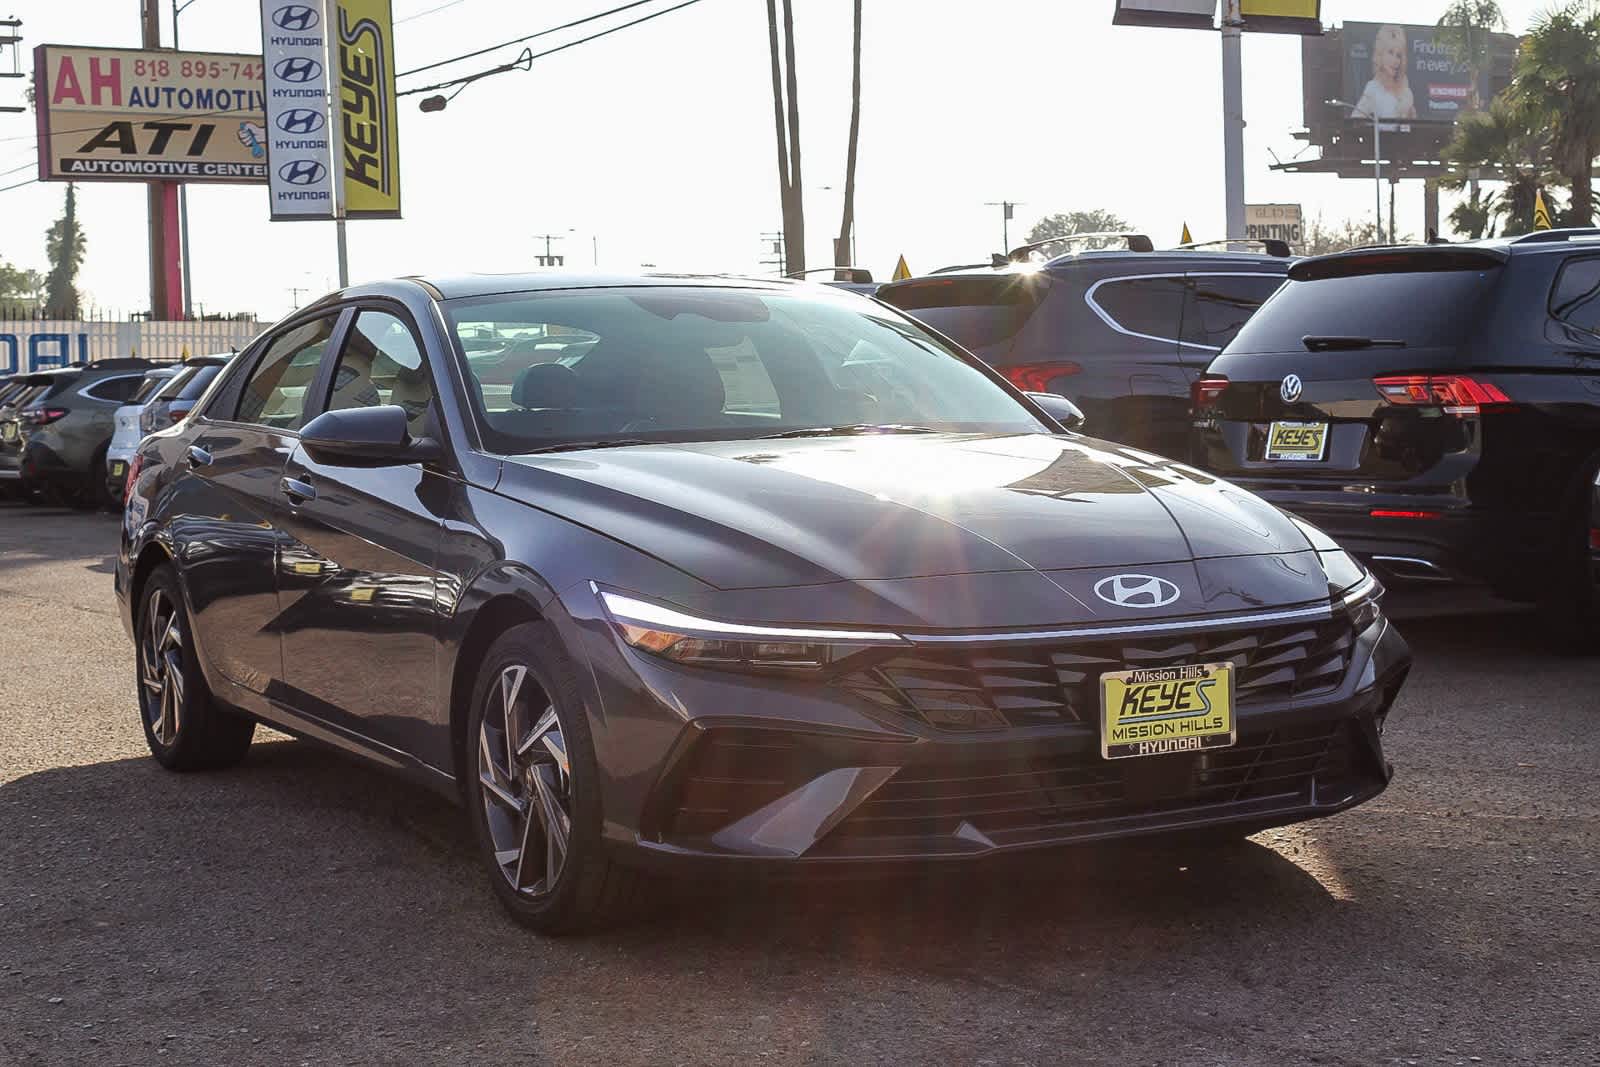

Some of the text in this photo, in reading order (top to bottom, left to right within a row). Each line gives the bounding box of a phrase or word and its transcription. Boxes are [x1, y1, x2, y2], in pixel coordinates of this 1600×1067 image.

[271, 37, 322, 46] HYUNDAI
[134, 59, 170, 80] 818
[52, 56, 122, 106] AH
[273, 89, 325, 98] HYUNDAI
[337, 5, 386, 196] KEYES
[76, 120, 216, 156] ATI
[276, 140, 327, 149] HYUNDAI
[71, 160, 268, 176] AUTOMOTIVE CENTE
[278, 191, 329, 200] HYUNDAI
[1273, 429, 1323, 448] KEYES
[1134, 666, 1202, 683] Mission Hills
[1118, 679, 1216, 721] KEYES
[1112, 717, 1223, 740] MISSION HILLS
[1139, 736, 1201, 754] HYUNDAI
